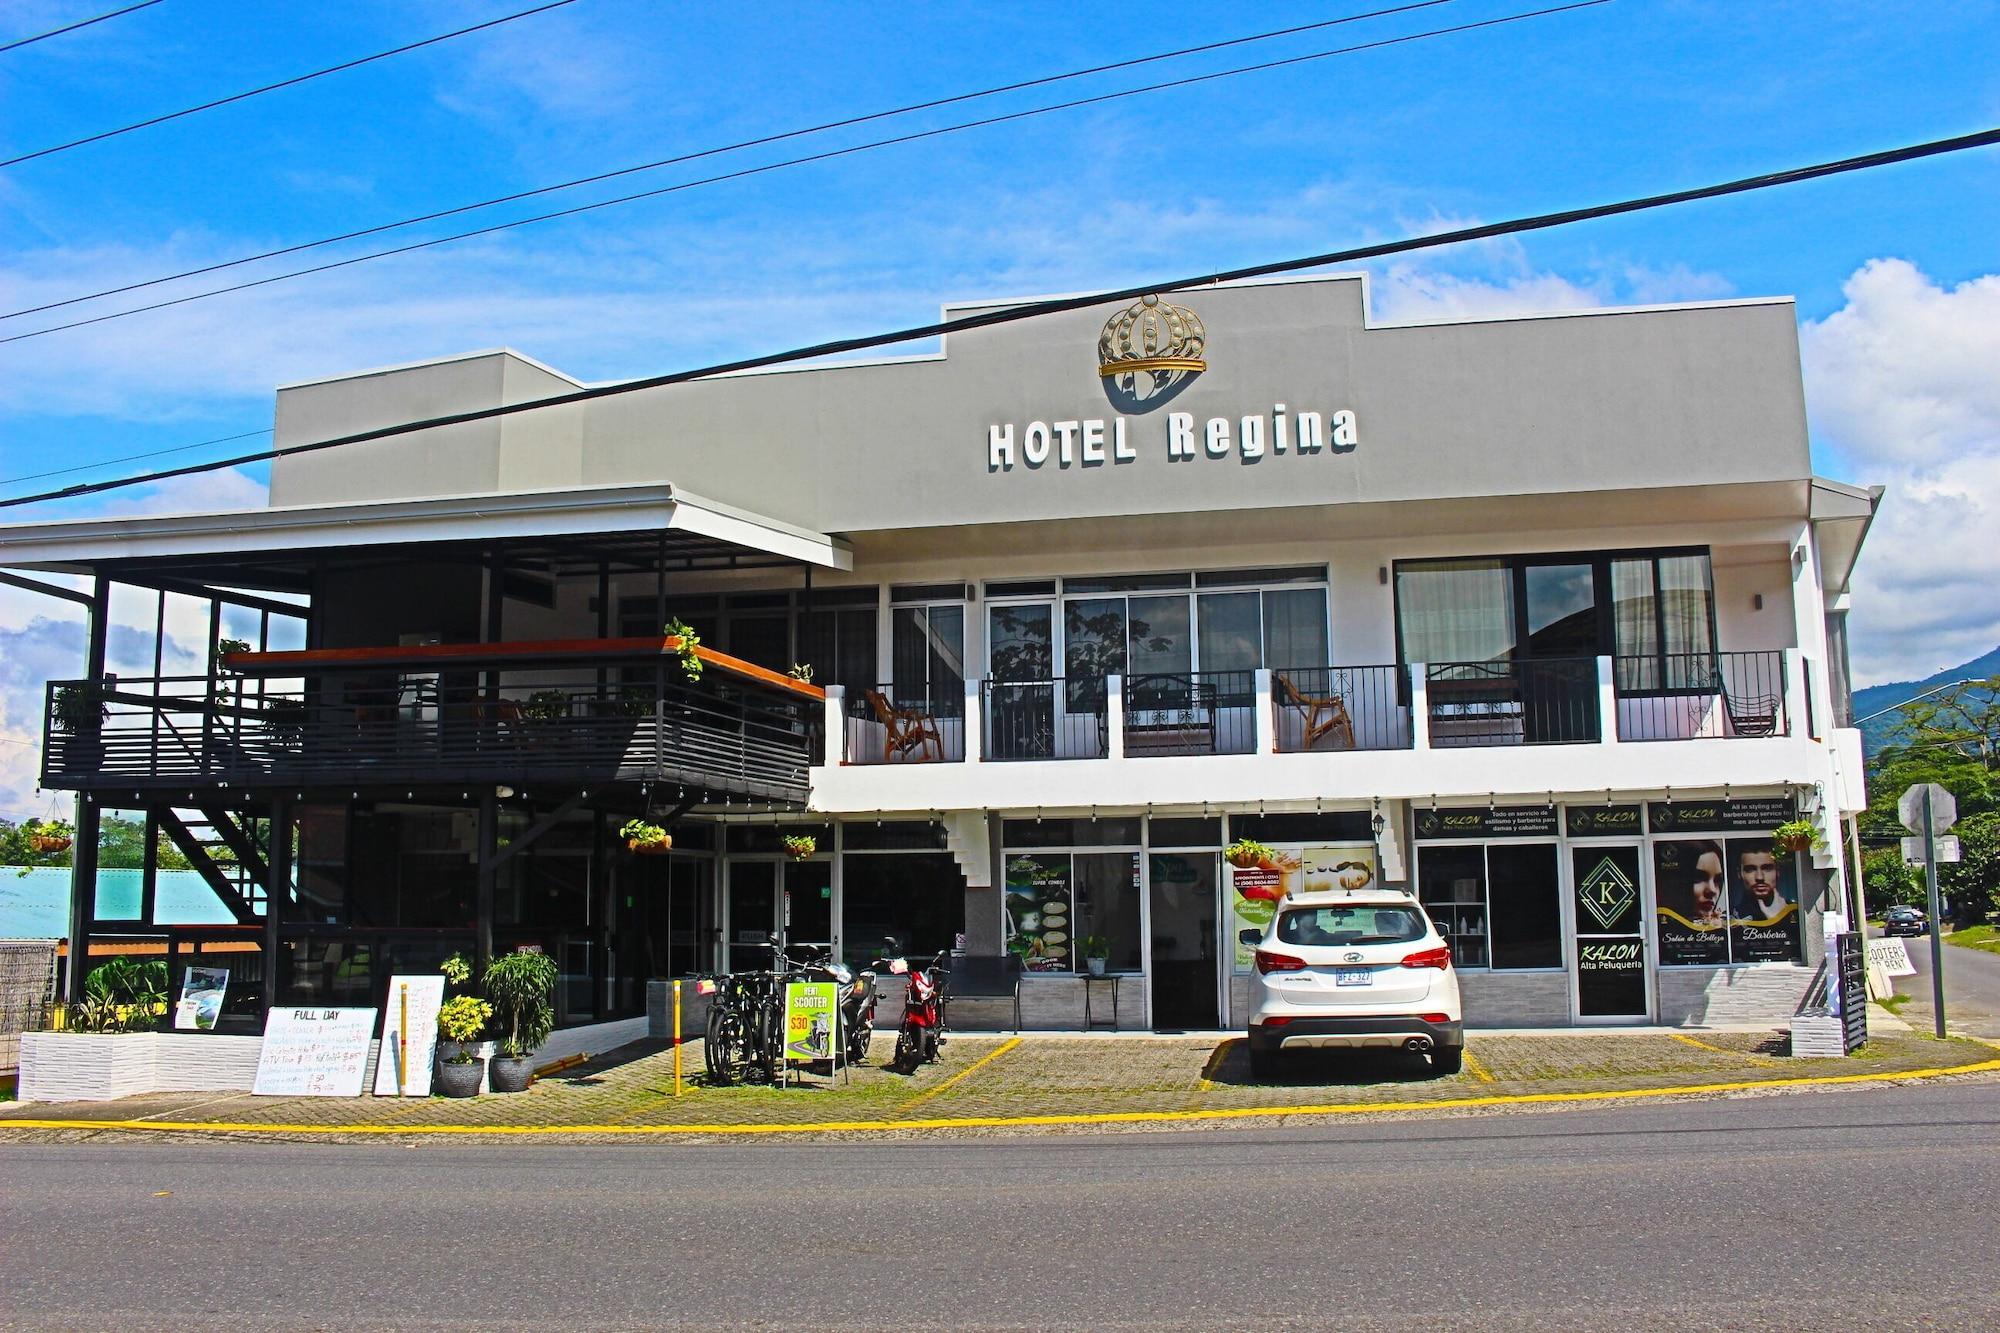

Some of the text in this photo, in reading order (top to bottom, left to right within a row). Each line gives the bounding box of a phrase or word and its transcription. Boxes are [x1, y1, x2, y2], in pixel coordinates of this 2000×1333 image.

[989, 404, 1357, 467] HOTEL Regina
[1749, 803, 1769, 811] styling
[1594, 811, 1638, 823] KALON
[1679, 808, 1717, 819] KALON
[1443, 815, 1482, 826] KALON
[1600, 882, 1616, 905] K
[1581, 944, 1640, 960] KALON
[1581, 962, 1597, 970] Alta
[804, 986, 818, 995] RENT
[794, 996, 828, 1008] SCOOTER
[294, 1010, 340, 1020] FULL DAY
[791, 1017, 807, 1030] $30
